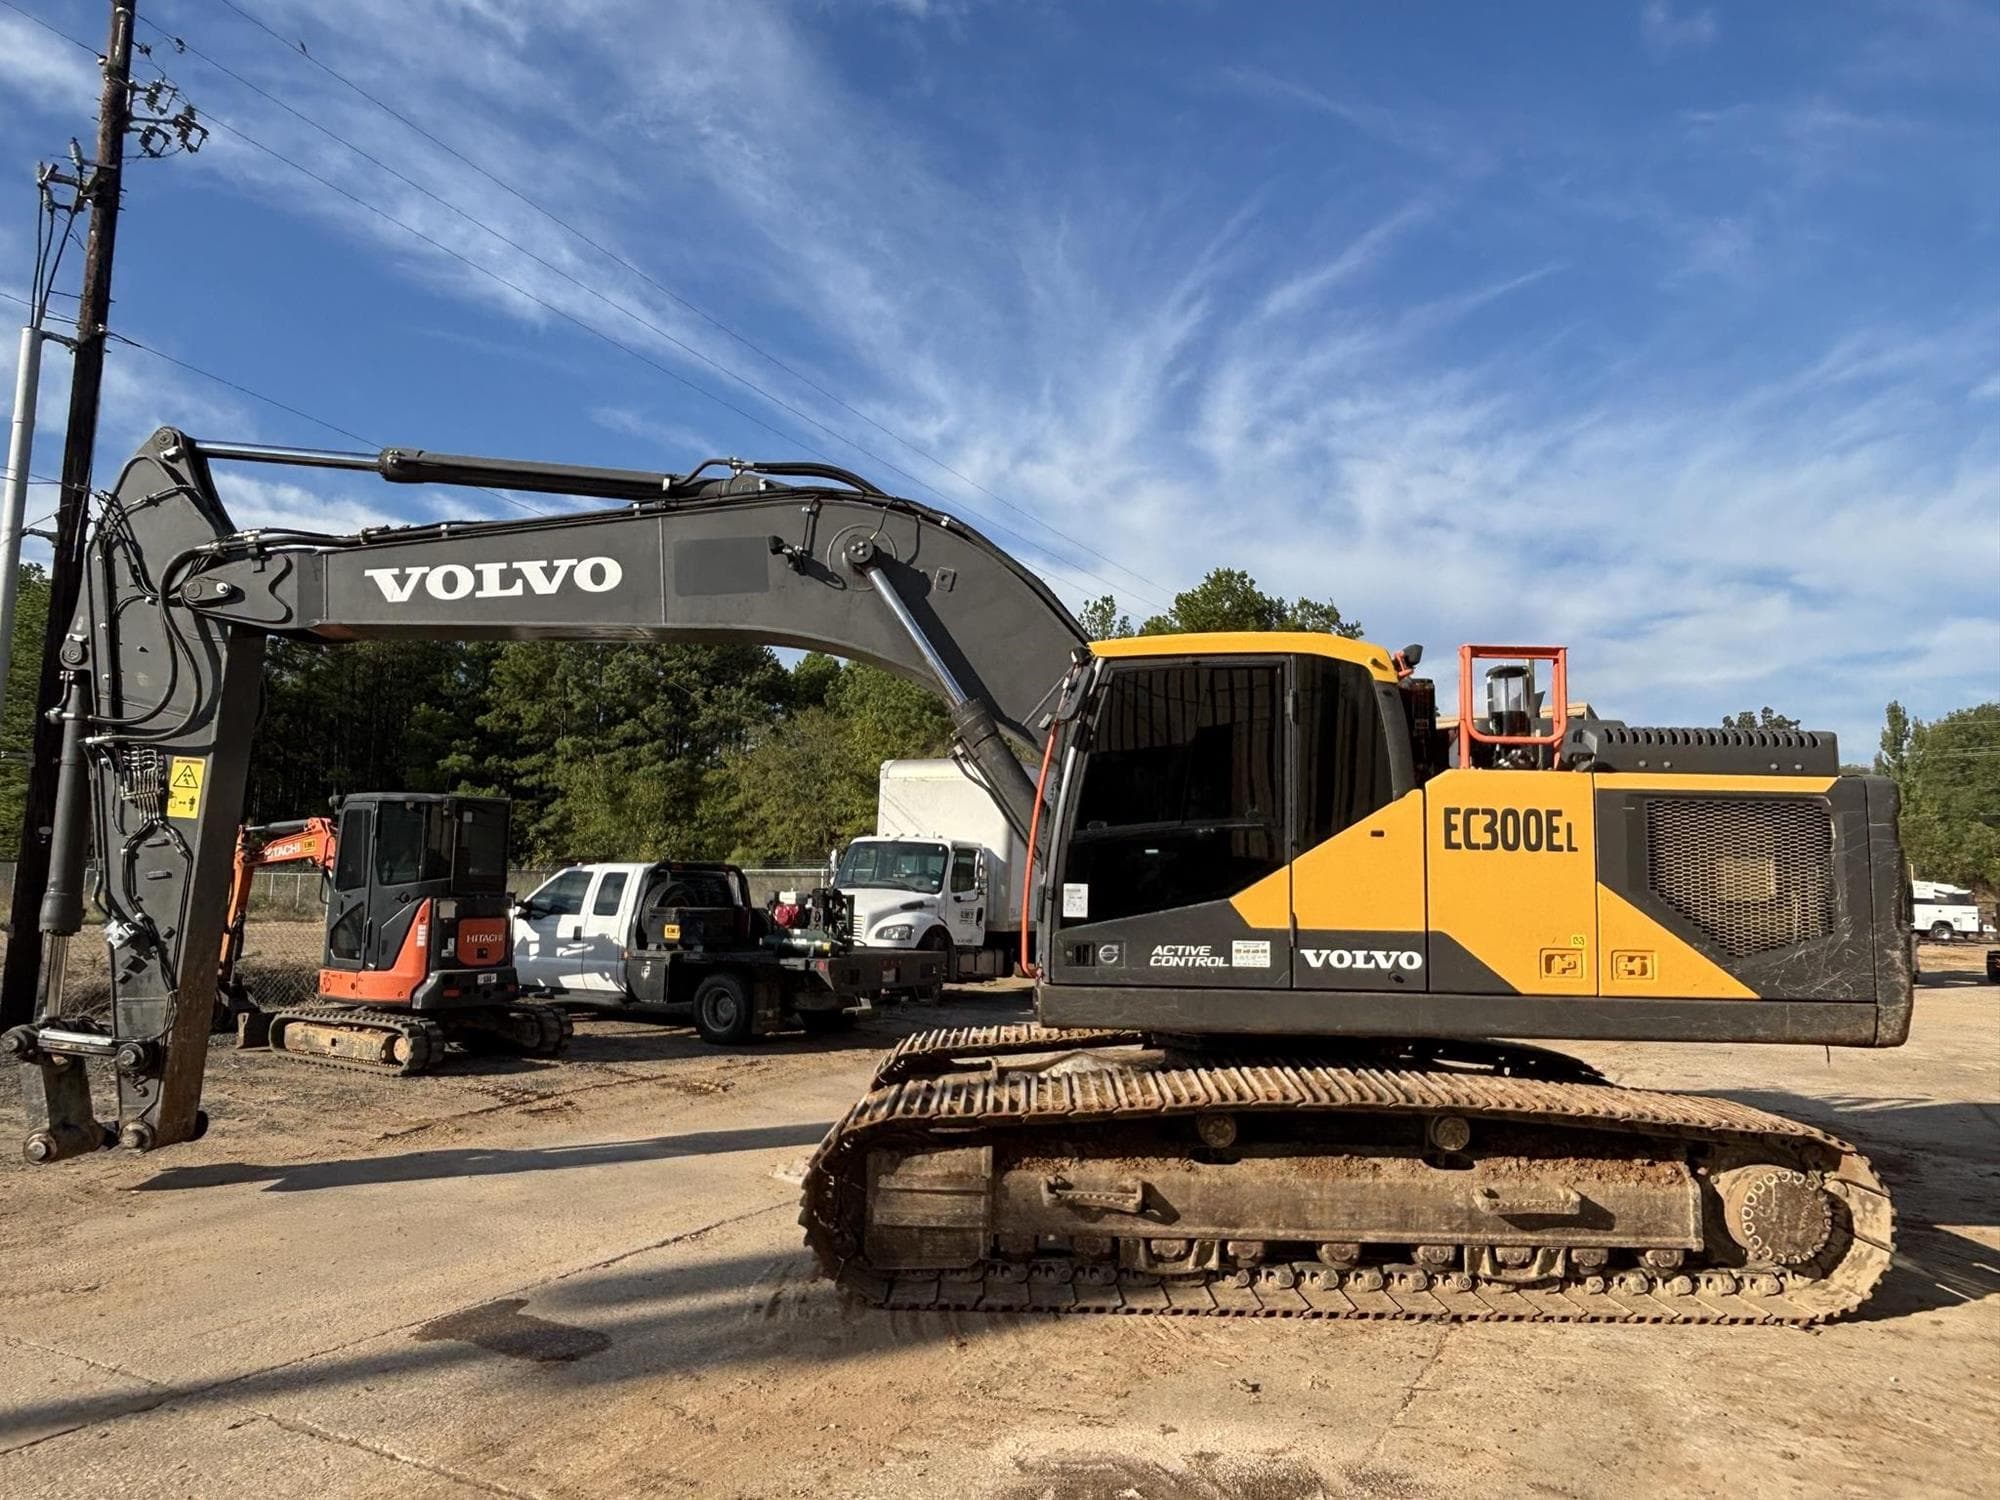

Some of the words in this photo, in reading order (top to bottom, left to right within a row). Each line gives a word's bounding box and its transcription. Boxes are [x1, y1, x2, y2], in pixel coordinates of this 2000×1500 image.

[364, 556, 623, 603] VOLVO
[466, 933, 504, 944] HITACHI
[1151, 945, 1212, 956] ACTIVE
[1149, 956, 1230, 967] CONTROL
[1299, 949, 1423, 970] VOLVO
